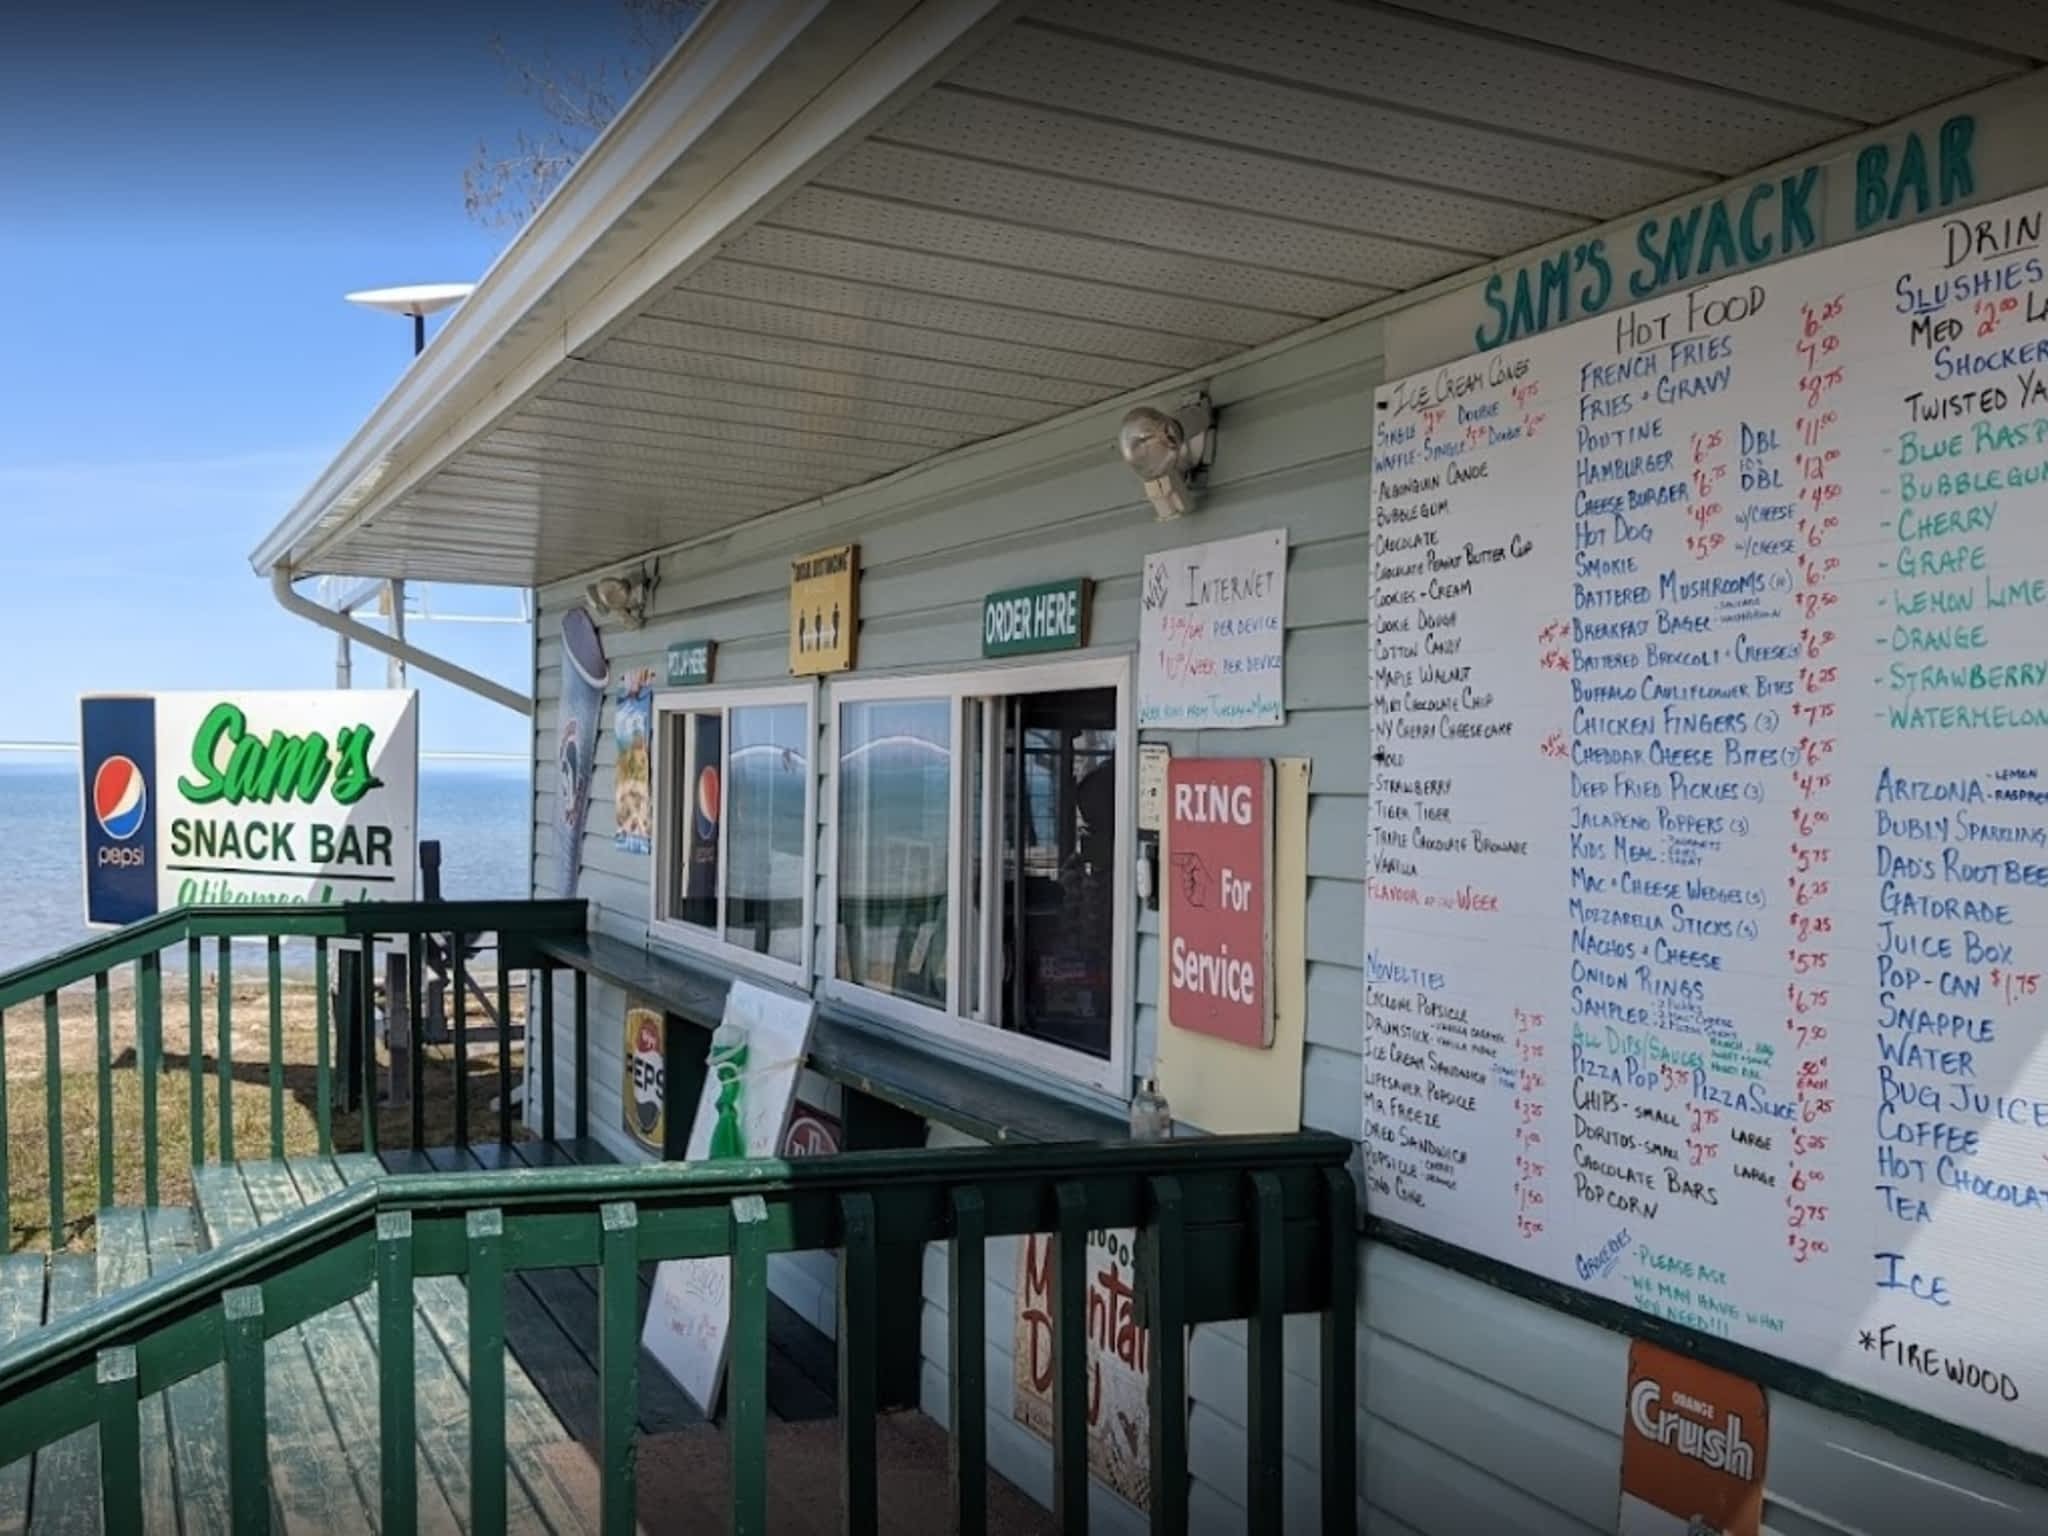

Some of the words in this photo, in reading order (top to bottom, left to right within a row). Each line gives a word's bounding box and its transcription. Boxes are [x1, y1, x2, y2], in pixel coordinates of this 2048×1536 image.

[1474, 238, 1613, 352] SAM'S
[1628, 165, 1822, 299] SNACK
[1854, 115, 1978, 233] BAR
[1896, 259, 2043, 313] SLUSHIES
[1616, 312, 1671, 354] HOT
[1688, 285, 1766, 333] FOOD
[1911, 315, 1963, 350] MED
[1580, 354, 1656, 392] FRENCH
[1670, 336, 1733, 373] FRIES
[1394, 383, 1429, 416] ICE
[1435, 370, 1484, 403] CREAM
[1579, 392, 1632, 421] FRIES
[1656, 365, 1731, 405] GRAVY
[1905, 388, 2007, 423] TWISTED
[1576, 418, 1663, 454] POUTINE
[1898, 432, 1964, 466] BLUE
[1576, 450, 1674, 488] HAMBURGER
[1740, 422, 1781, 456] DBL
[1447, 462, 1489, 486] CANOE
[1741, 472, 1784, 492] DBL
[1575, 521, 1606, 551] HOT
[1614, 514, 1654, 545] DOG
[1899, 501, 1998, 543] CHERRY
[1464, 542, 1506, 566] BUTTER
[1576, 551, 1639, 579] SMOKIE
[1896, 546, 1987, 578] GRAPE
[1184, 564, 1275, 608] INTERNET
[1428, 578, 1473, 600] CREAM
[1573, 582, 1651, 610] BATTERED
[1658, 569, 1765, 603] MUSHROOMS
[1894, 586, 1974, 616] LEMON
[1986, 576, 2046, 609] LIME
[986, 597, 1031, 645] ORDER
[1034, 591, 1077, 638] HERE
[1572, 616, 1649, 644] BREAKFAST
[1891, 625, 1988, 651] ORANGE
[1420, 663, 1472, 685] WALNUT
[1571, 647, 1639, 674] BATTERED
[1646, 643, 1720, 668] BROCCOLI
[1888, 660, 2047, 693] STRAWBERRY
[1571, 677, 1637, 703] BUFFALO
[1641, 675, 1751, 702] CAULIFLOWER
[1755, 674, 1796, 697] BITES
[1572, 705, 1655, 738] CHICKEN
[1663, 703, 1748, 735] FINGERS
[1886, 693, 2048, 730] WATERMELON
[177, 702, 384, 805] Sam's
[1571, 740, 1643, 768] CHEDDAR
[1648, 739, 1714, 768] CHEESE
[1376, 774, 1452, 796] STRAWBERRY
[1570, 771, 1609, 800] DEEP
[1614, 771, 1662, 796] FRIED
[1669, 771, 1740, 801] PICKLES
[1876, 767, 1985, 803] ARIZONA
[1174, 784, 1252, 825] RING
[1415, 802, 1450, 822] TIGER
[1571, 806, 1652, 832] JALAPENO
[1656, 806, 1724, 836] POPPERS
[170, 818, 297, 862] SNACK
[310, 824, 393, 867] BAR
[1876, 808, 1949, 843] BUBLY
[1954, 808, 2047, 849] SPARKLING
[99, 845, 145, 868] pepsi
[1570, 832, 1606, 860] KIDS
[1614, 835, 1658, 864] MEAL
[1878, 845, 1937, 881] DAD'S
[1221, 868, 1252, 912] For
[1571, 867, 1606, 894] MAC
[1620, 870, 1681, 900] CHEESE
[1686, 877, 1743, 904] WEDGES
[1880, 880, 2014, 926] GATORADE
[1569, 897, 1664, 931] MOZZARELLA
[1671, 903, 1733, 939] STICKS
[1571, 926, 1636, 959] NACHOS
[1653, 937, 1723, 972] CHEESE
[1877, 921, 1952, 958] JUICE
[1963, 930, 2014, 965] BOX
[1172, 936, 1255, 1005] Service
[1367, 953, 1445, 990] NOVELTIES
[1571, 959, 1629, 991] ONION
[1635, 964, 1705, 1001] RINGS
[1571, 985, 1649, 1025] SAMPLER
[1878, 991, 1995, 1043] SNAPPLE
[1427, 1051, 1487, 1086] SANDWICH
[1878, 1033, 1976, 1076] WATER
[1427, 1080, 1477, 1112] POPSICLE
[1571, 1044, 1622, 1087] PIZZA
[1625, 1056, 1660, 1091] POP
[1692, 1067, 1749, 1112] PIZZA
[1879, 1065, 1941, 1112] BUG
[1951, 1083, 2048, 1126] JUICE
[1388, 1097, 1441, 1129] FREEZE
[1878, 1103, 1979, 1155] COFFEE
[1731, 1128, 1773, 1151] LARGE
[1573, 1144, 1656, 1190] CHOCOLATE
[1664, 1167, 1720, 1206] BARS
[1733, 1164, 1776, 1188] LARGE
[1878, 1146, 1927, 1182] HOT
[1573, 1171, 1659, 1220] POPCORN
[1876, 1185, 1933, 1223] TEA
[1874, 1253, 1950, 1306] ICE
[1631, 1379, 1754, 1481] Crush
